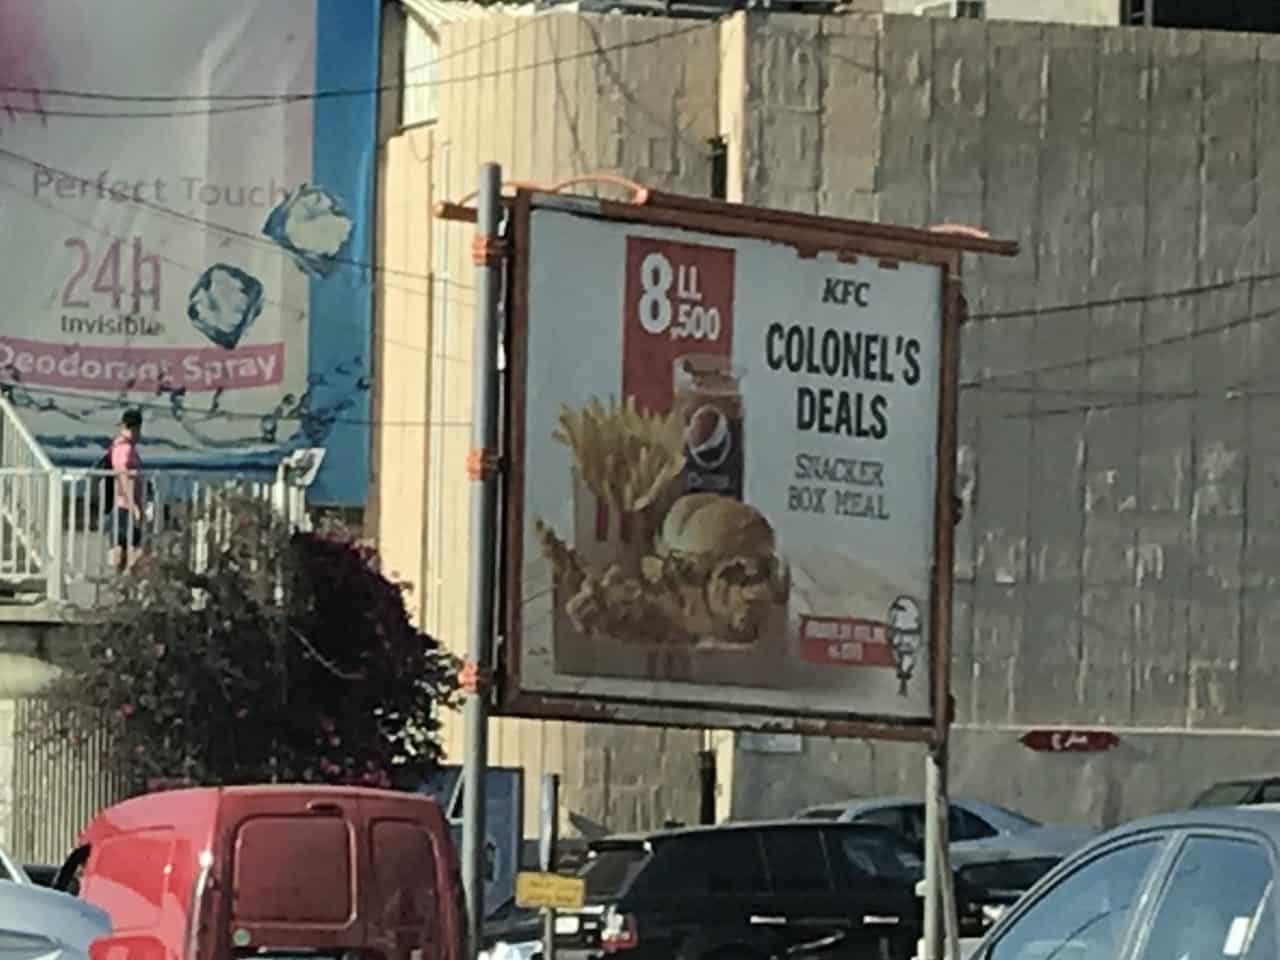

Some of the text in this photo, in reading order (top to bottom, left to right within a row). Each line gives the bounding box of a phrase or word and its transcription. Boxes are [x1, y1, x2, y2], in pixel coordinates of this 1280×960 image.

[32, 168, 287, 208] Perfect Touch
[61, 237, 161, 314] 24h
[639, 252, 673, 334] 8
[822, 277, 871, 308] KFC
[61, 313, 165, 338] Invisible
[182, 353, 278, 384] Spray
[765, 321, 921, 386] COLONEL'S
[796, 386, 888, 440] DEALS
[794, 452, 885, 487] SNACKER
[787, 485, 890, 520] BOX MEAL
